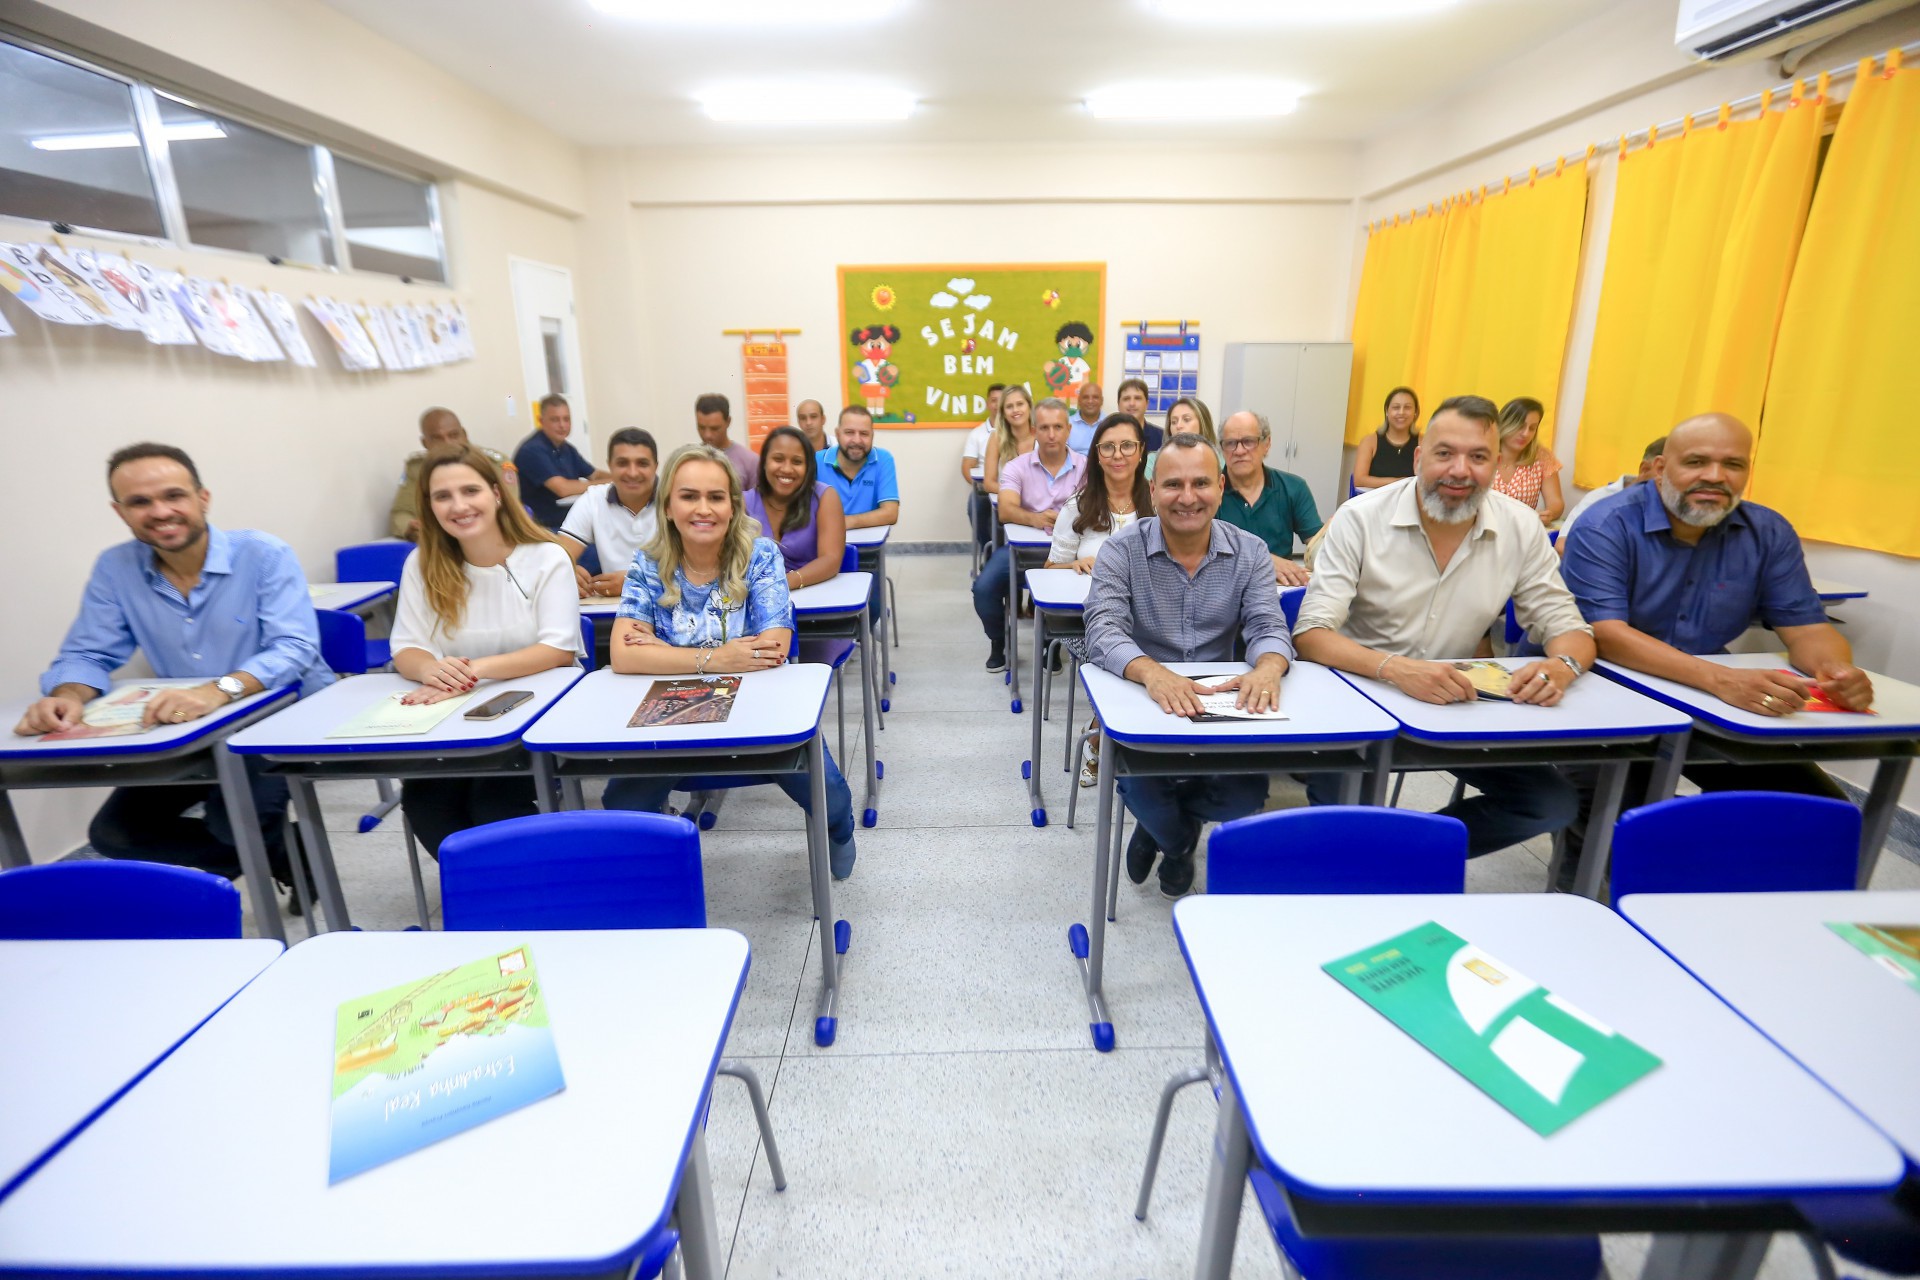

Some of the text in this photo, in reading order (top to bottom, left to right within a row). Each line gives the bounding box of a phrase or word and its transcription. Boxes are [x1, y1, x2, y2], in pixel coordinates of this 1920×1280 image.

[921, 313, 1019, 350] SEJAM
[943, 354, 994, 375] BEM
[429, 1054, 515, 1097] Estradinha
[384, 1088, 420, 1123] Real
